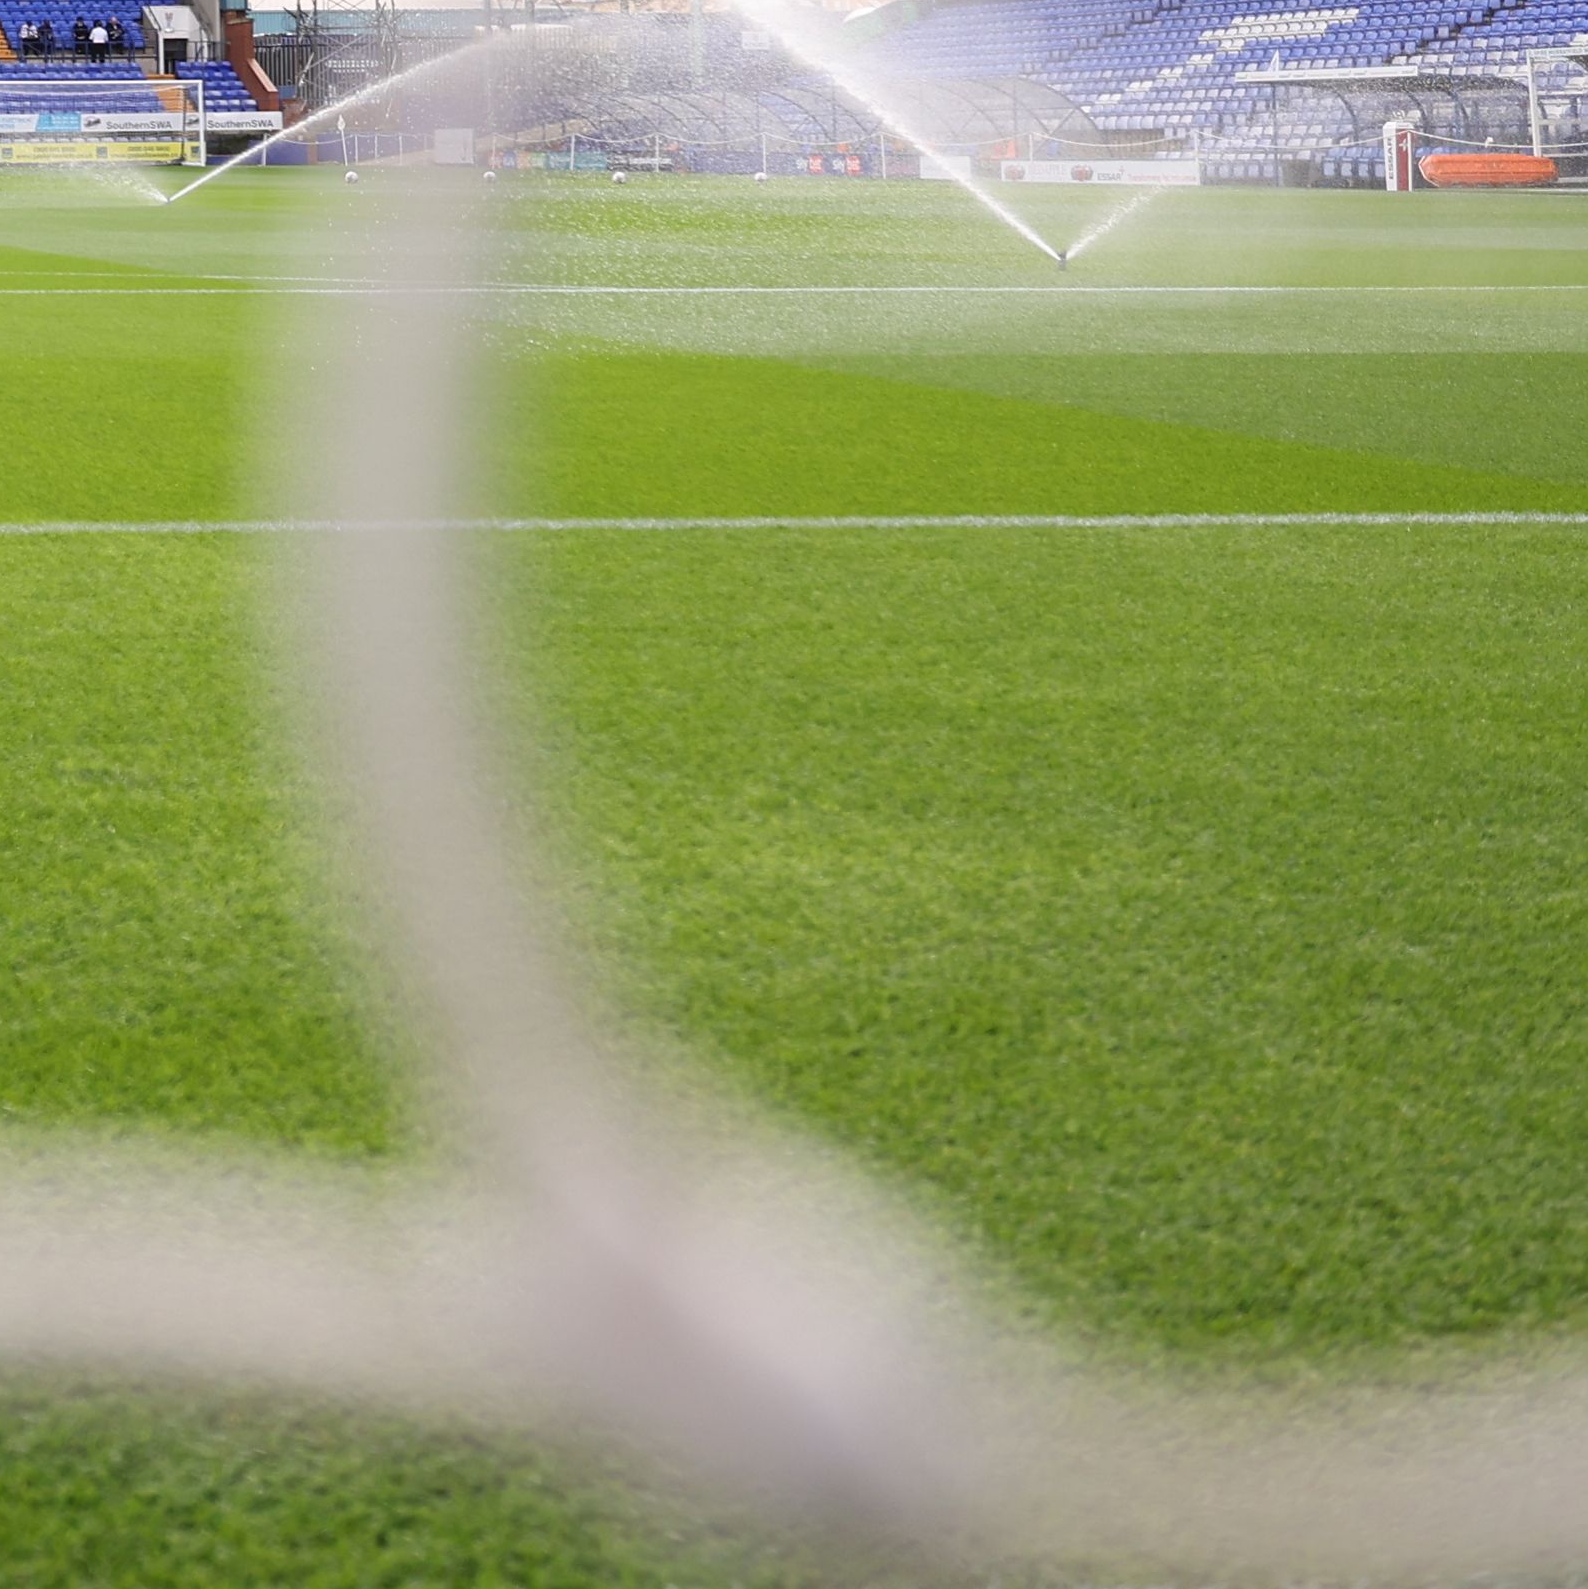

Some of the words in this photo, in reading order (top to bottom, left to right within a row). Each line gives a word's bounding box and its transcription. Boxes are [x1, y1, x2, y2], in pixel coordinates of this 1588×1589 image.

[106, 121, 172, 130] SouthernSWA
[207, 120, 273, 130] SouthernSWA
[1098, 172, 1121, 181] ESSAR
